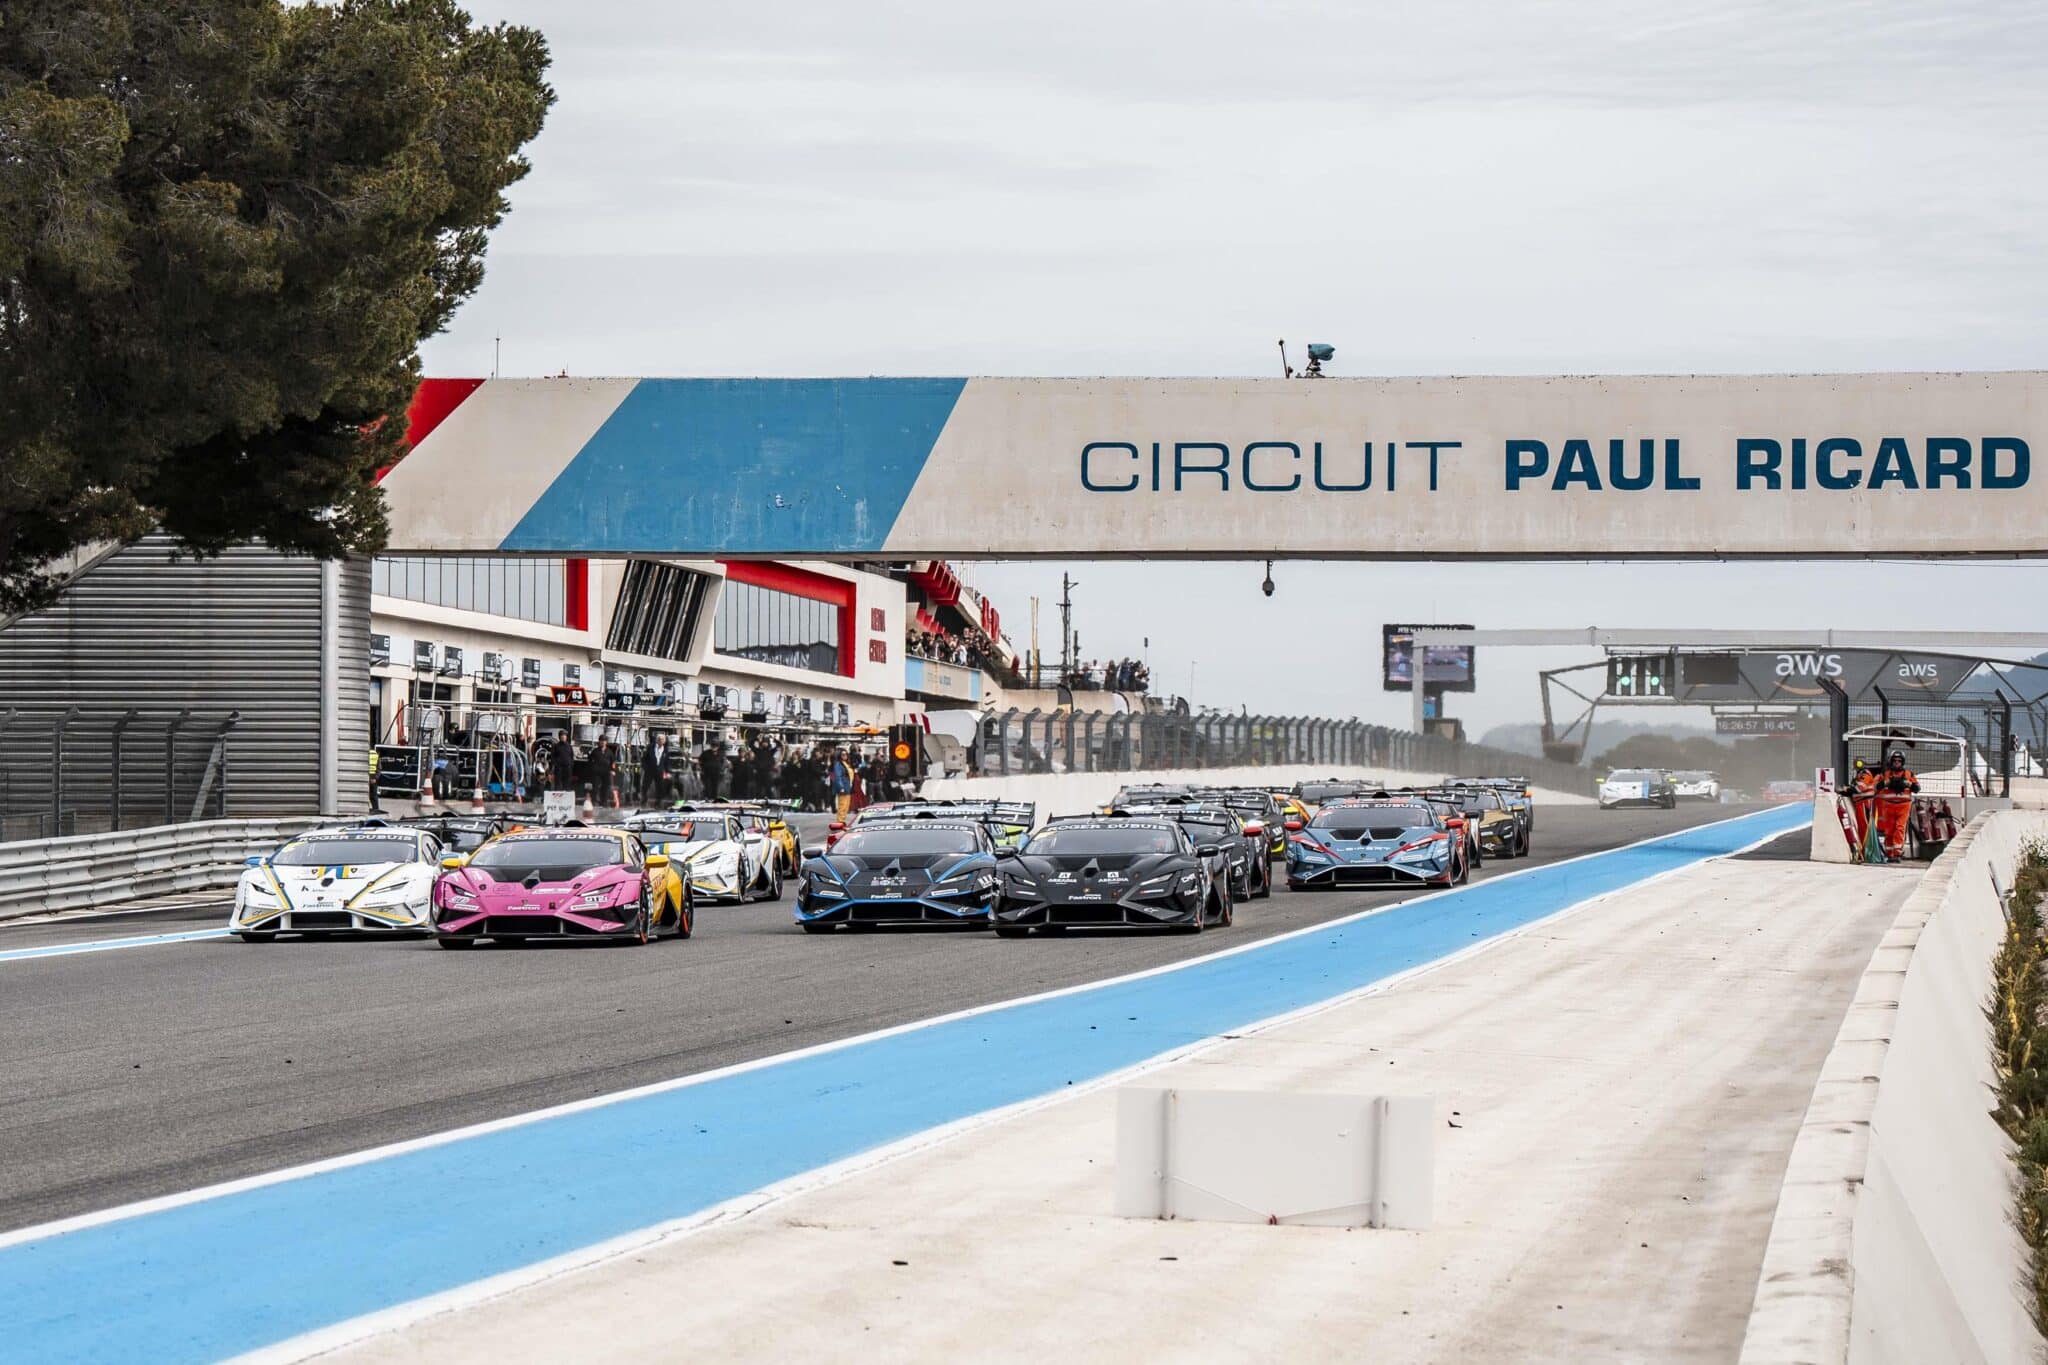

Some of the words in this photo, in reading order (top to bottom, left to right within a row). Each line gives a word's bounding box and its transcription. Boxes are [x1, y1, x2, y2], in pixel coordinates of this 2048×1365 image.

[1080, 441, 1462, 492] CIRCUIT
[1505, 438, 1700, 490] PAUL
[1736, 437, 2030, 489] RICARD
[1775, 653, 1843, 677] aws
[1898, 663, 1938, 677] aws
[1107, 823, 1168, 831] DUBUIS
[355, 833, 413, 841] DUBUIS
[556, 833, 616, 842] DUBUIS
